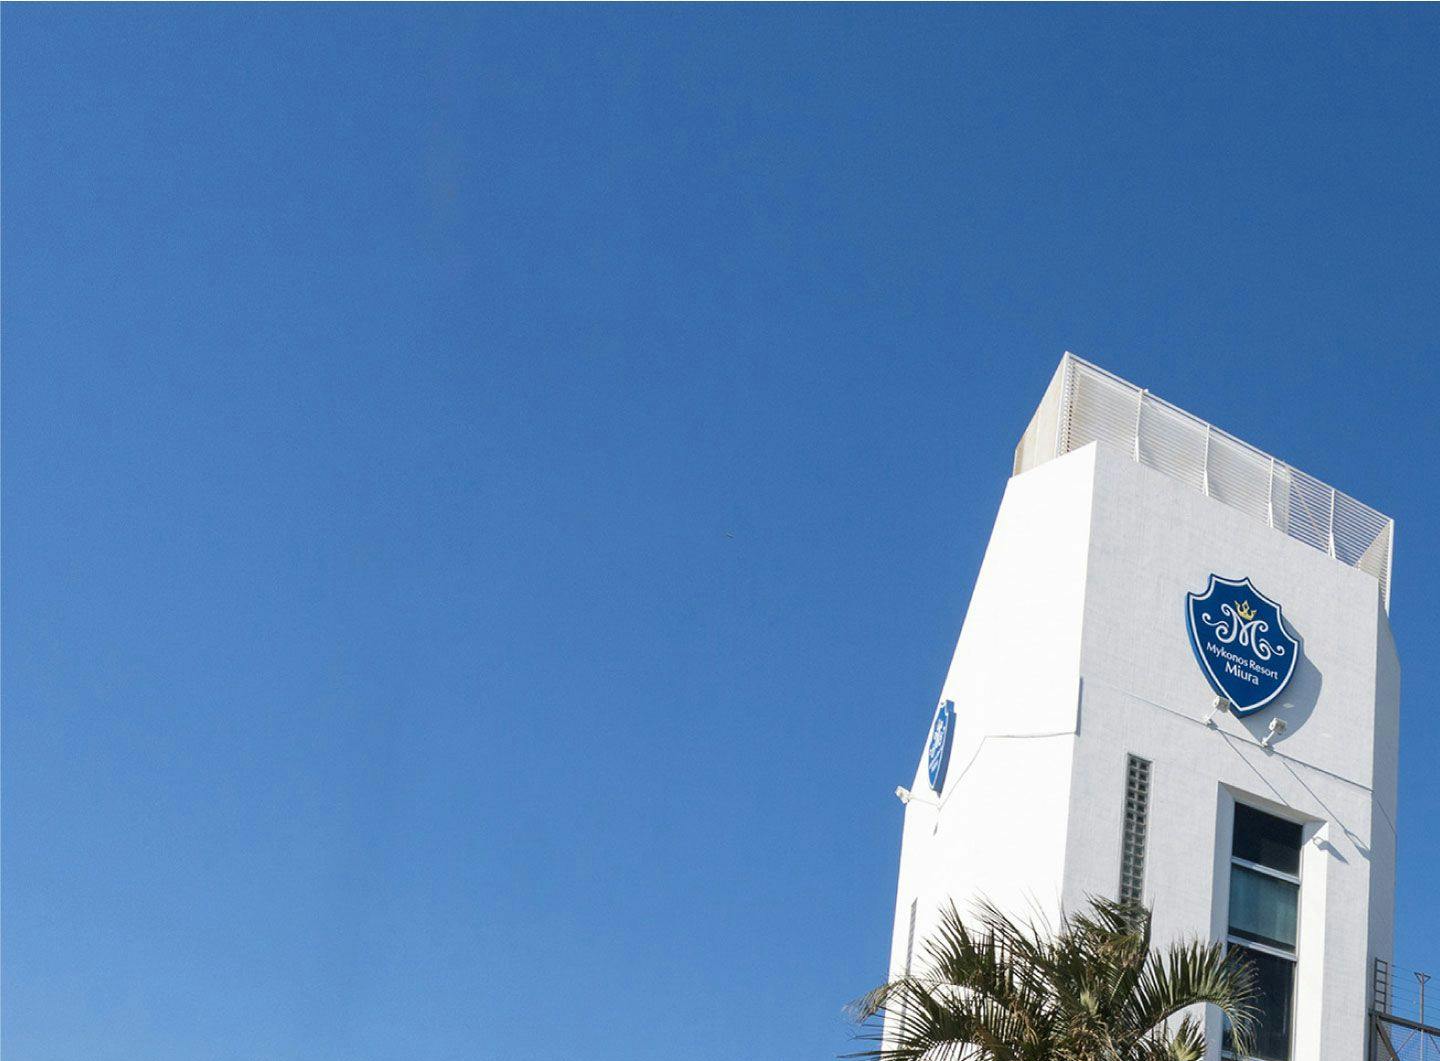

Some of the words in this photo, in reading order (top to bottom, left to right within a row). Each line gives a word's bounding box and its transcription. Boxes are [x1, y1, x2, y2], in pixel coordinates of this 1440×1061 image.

[1206, 642, 1249, 668] Mykonos
[1249, 659, 1279, 680] Resort
[1225, 660, 1259, 686] Miura
